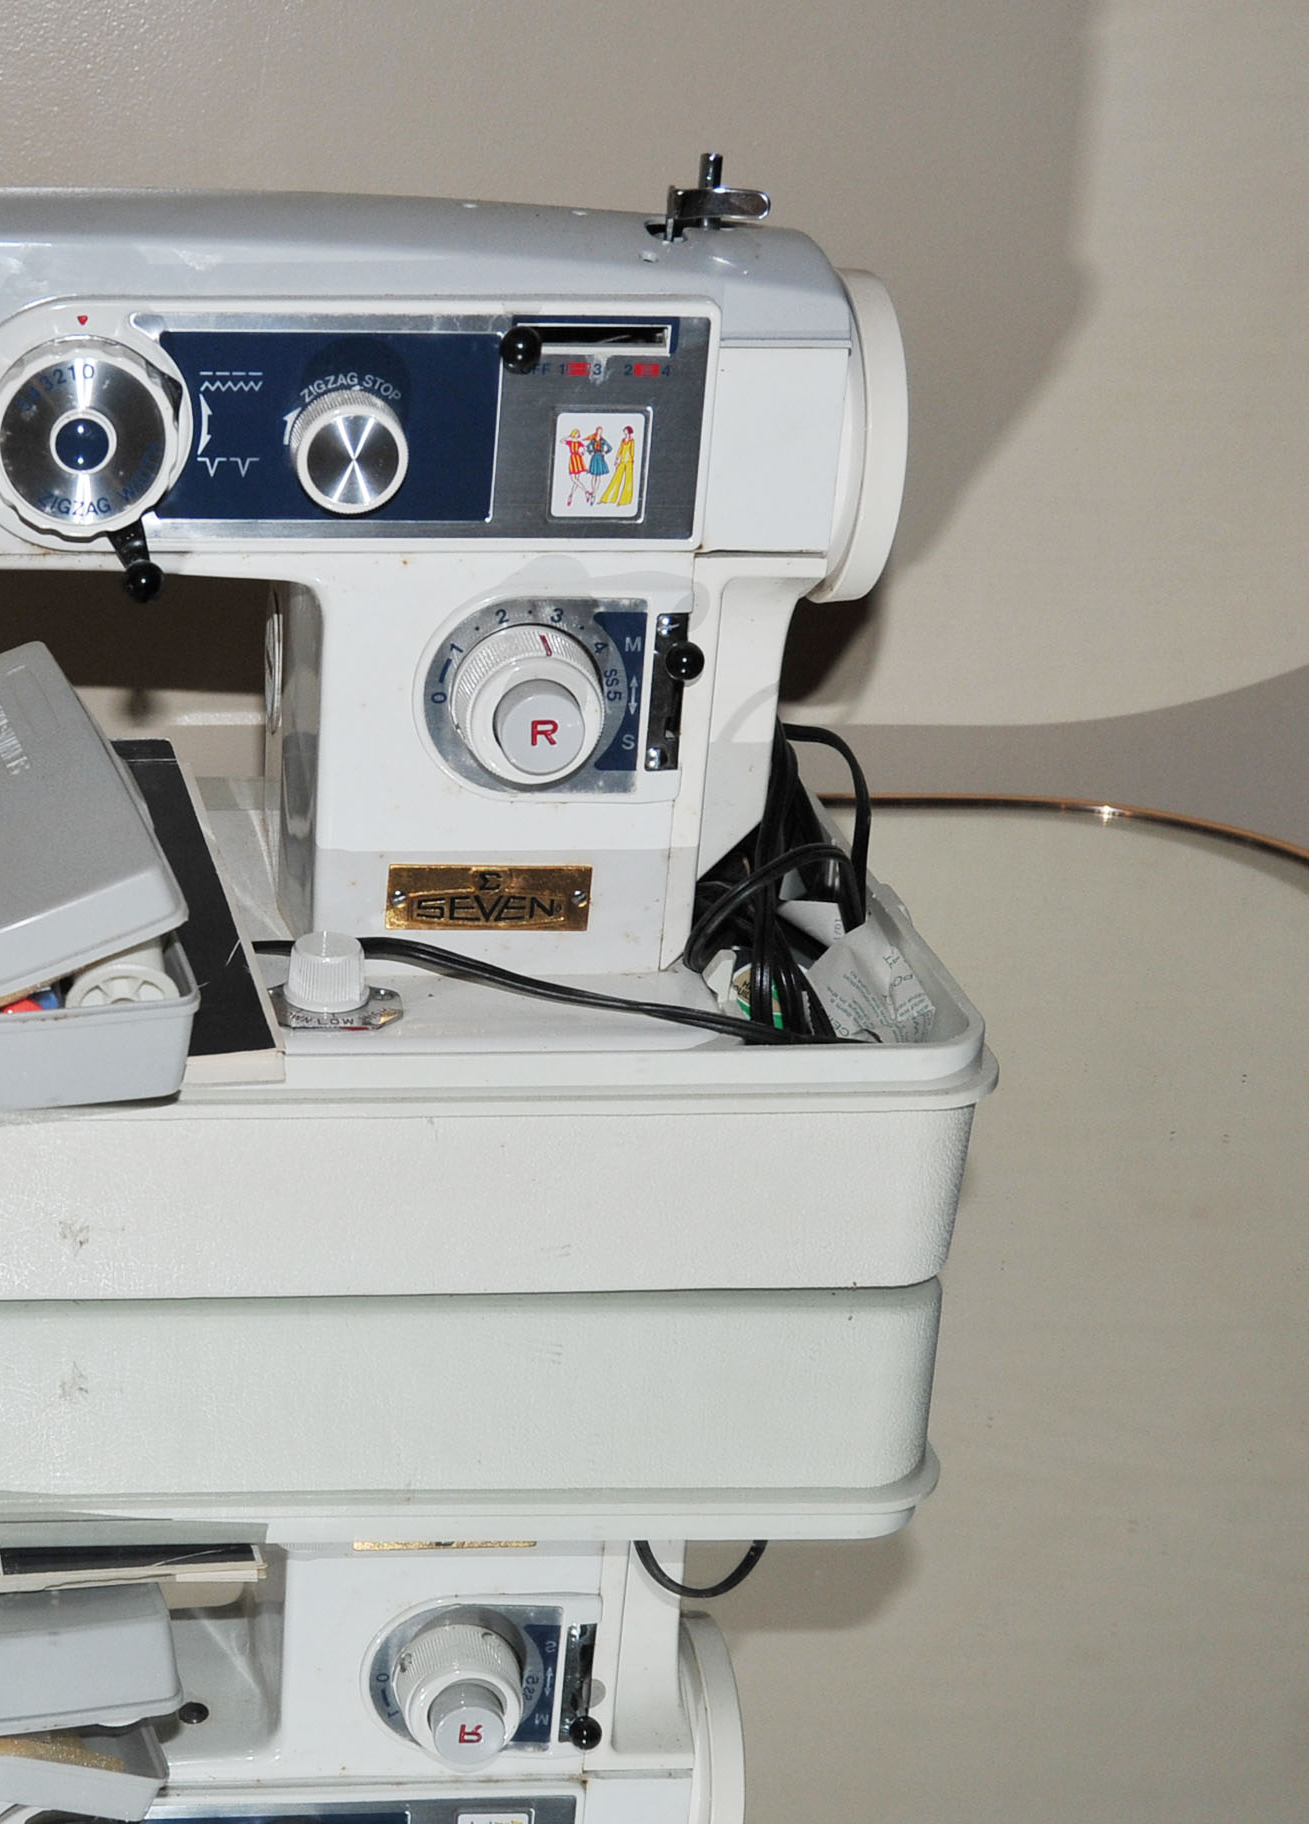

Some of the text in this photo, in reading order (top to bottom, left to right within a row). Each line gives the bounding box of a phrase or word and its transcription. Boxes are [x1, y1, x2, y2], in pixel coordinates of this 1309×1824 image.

[592, 363, 602, 376] 3
[624, 364, 633, 377] 2
[661, 365, 671, 377] 4
[299, 371, 402, 403] ZIGZAG STOP
[40, 492, 111, 516] ZIGZAG
[495, 608, 565, 623] 2 3
[449, 643, 465, 656] 1
[593, 641, 609, 654] 4
[624, 637, 641, 652] M
[430, 693, 448, 704] 0
[530, 719, 559, 746] R
[621, 735, 635, 749] S
[416, 894, 555, 922] SEVEN
